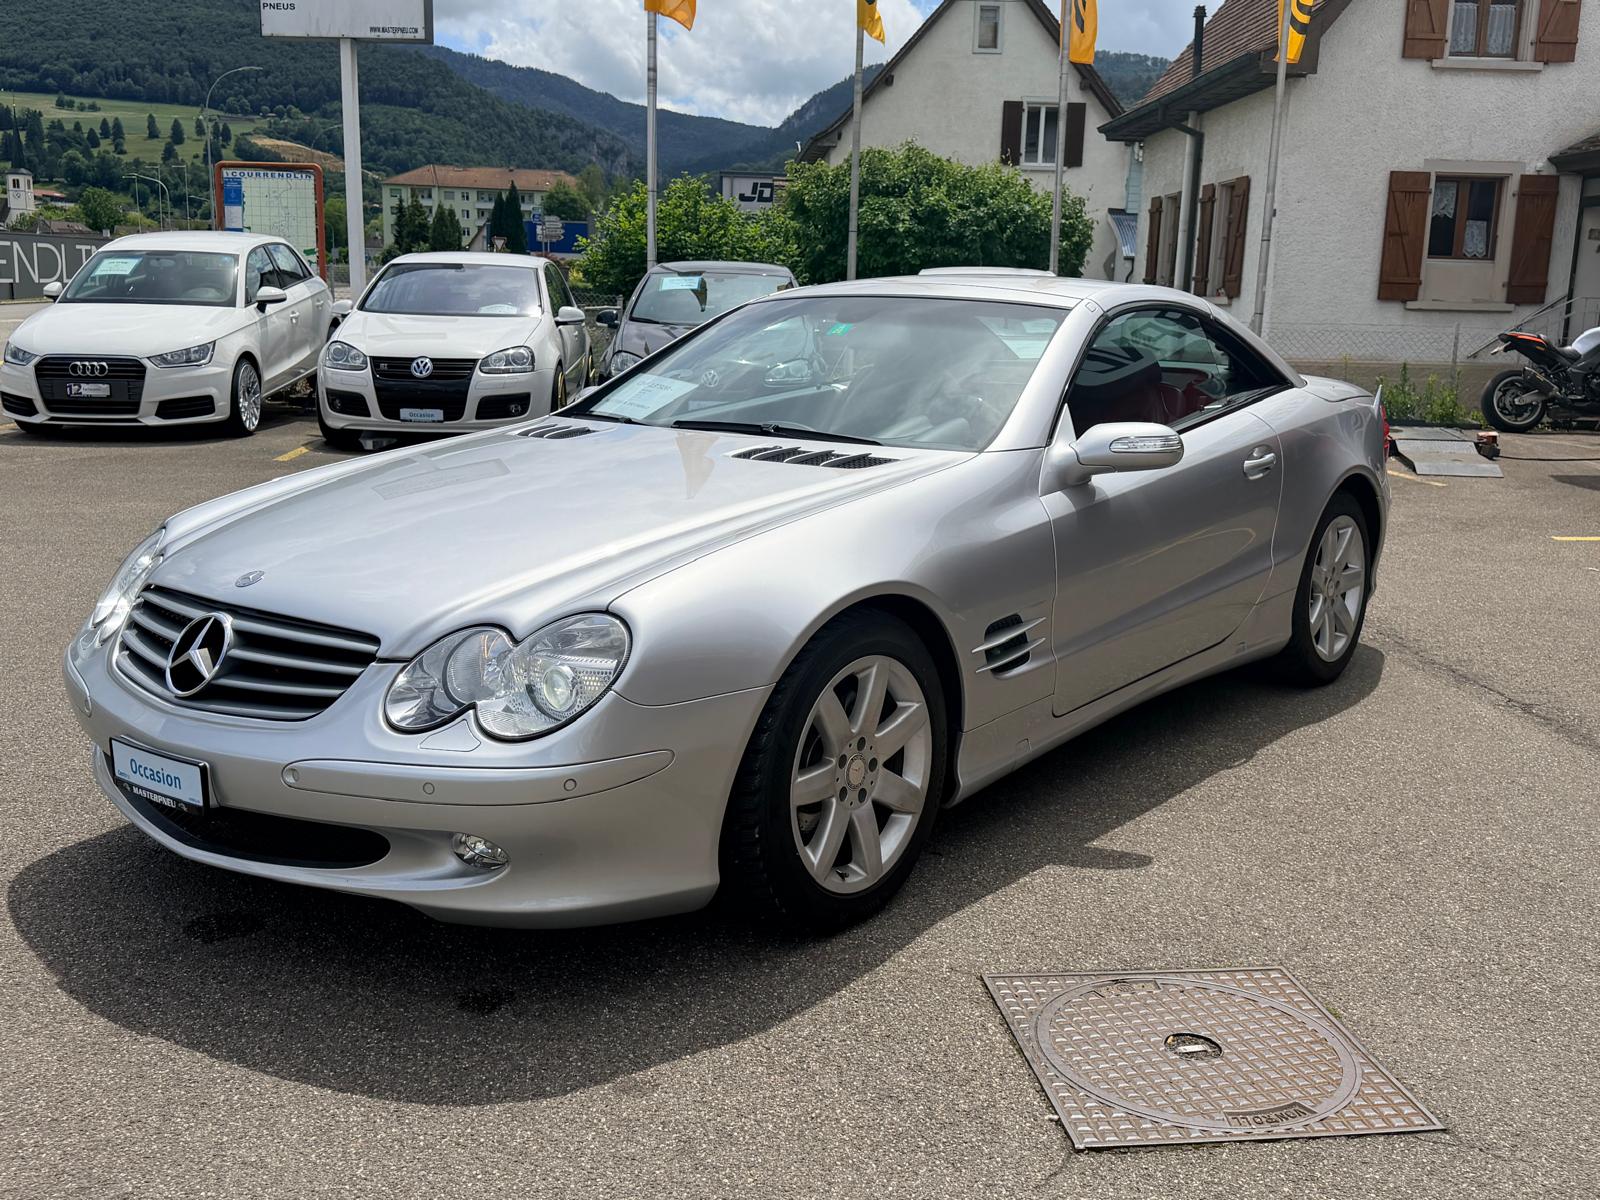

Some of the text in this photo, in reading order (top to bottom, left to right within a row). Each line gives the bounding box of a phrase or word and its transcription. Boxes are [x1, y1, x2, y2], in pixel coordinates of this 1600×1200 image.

[262, 2, 296, 11] PNEUS
[231, 170, 312, 180] COURRENDLIN
[129, 758, 182, 790] Occasion
[132, 786, 177, 808] MASTERPNEU
